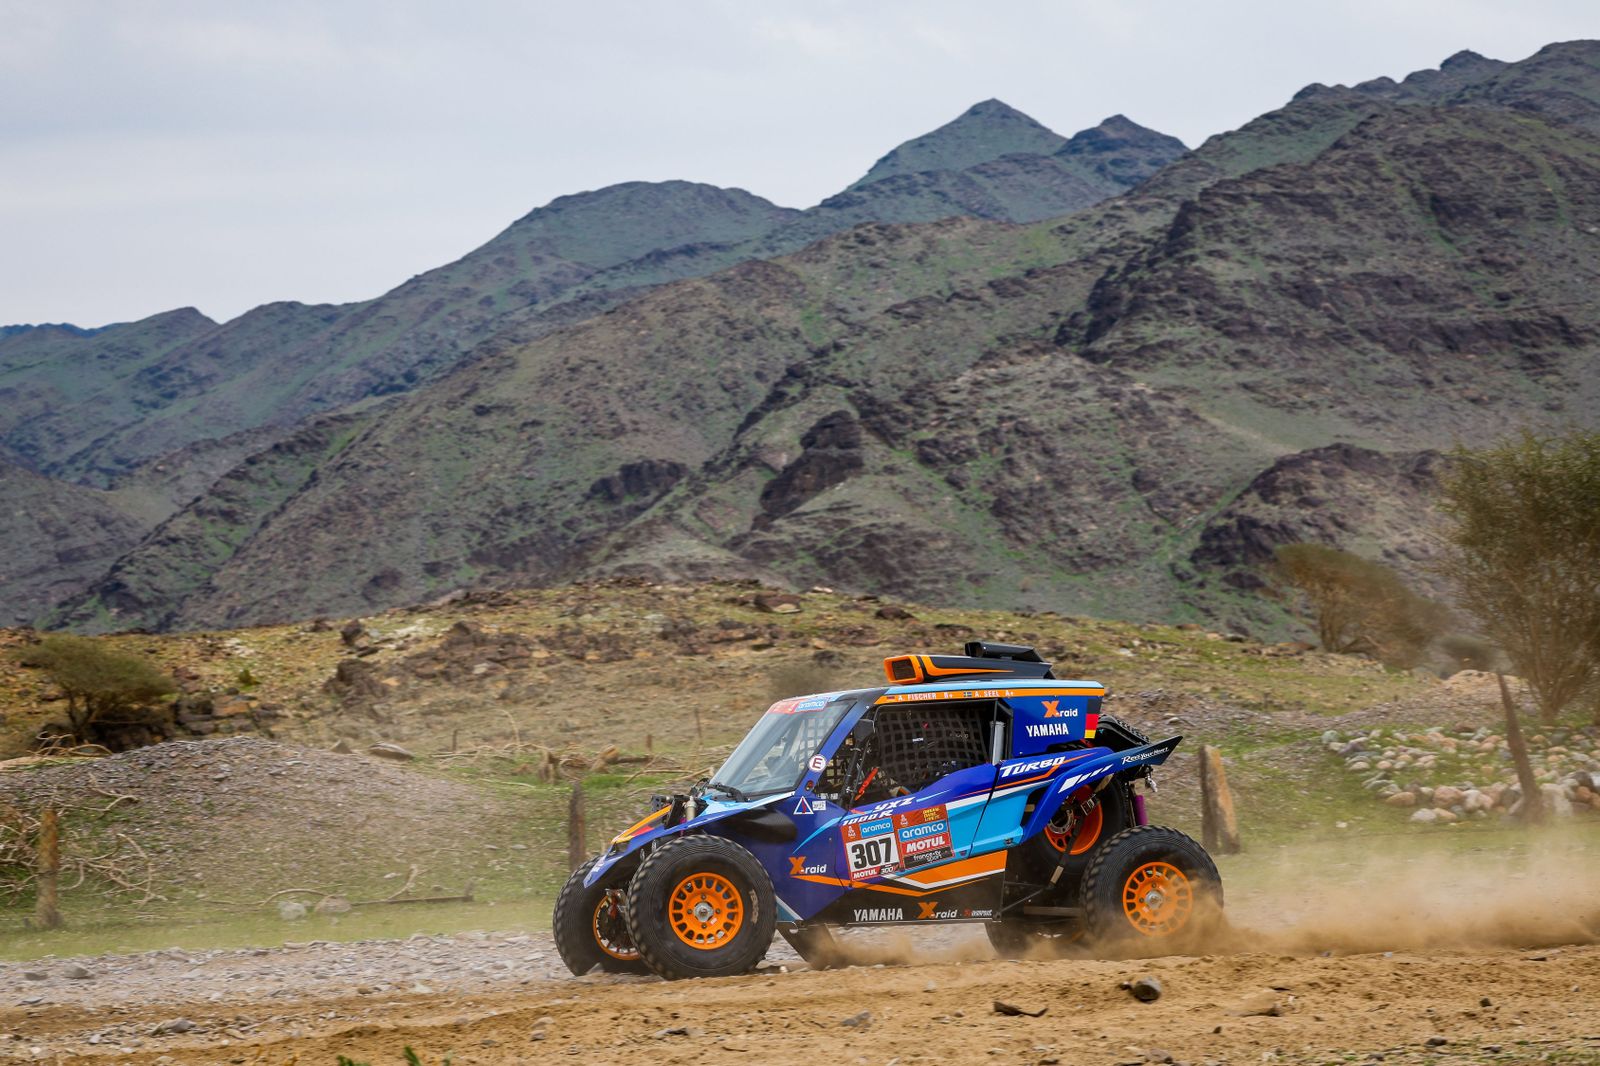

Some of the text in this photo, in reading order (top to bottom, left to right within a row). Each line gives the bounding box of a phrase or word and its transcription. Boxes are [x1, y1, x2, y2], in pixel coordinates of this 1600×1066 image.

[908, 693, 937, 701] FISCHER
[1026, 723, 1069, 738] YAMAHA
[812, 757, 823, 769] E
[1000, 756, 1066, 777] TURBO
[872, 797, 916, 813] YXZ
[862, 823, 891, 834] aramco
[902, 823, 944, 839] aramco
[906, 836, 946, 853] MOTUL
[851, 837, 892, 870] 307
[853, 869, 878, 879] MOTUL
[853, 908, 904, 922] YAMAHA
